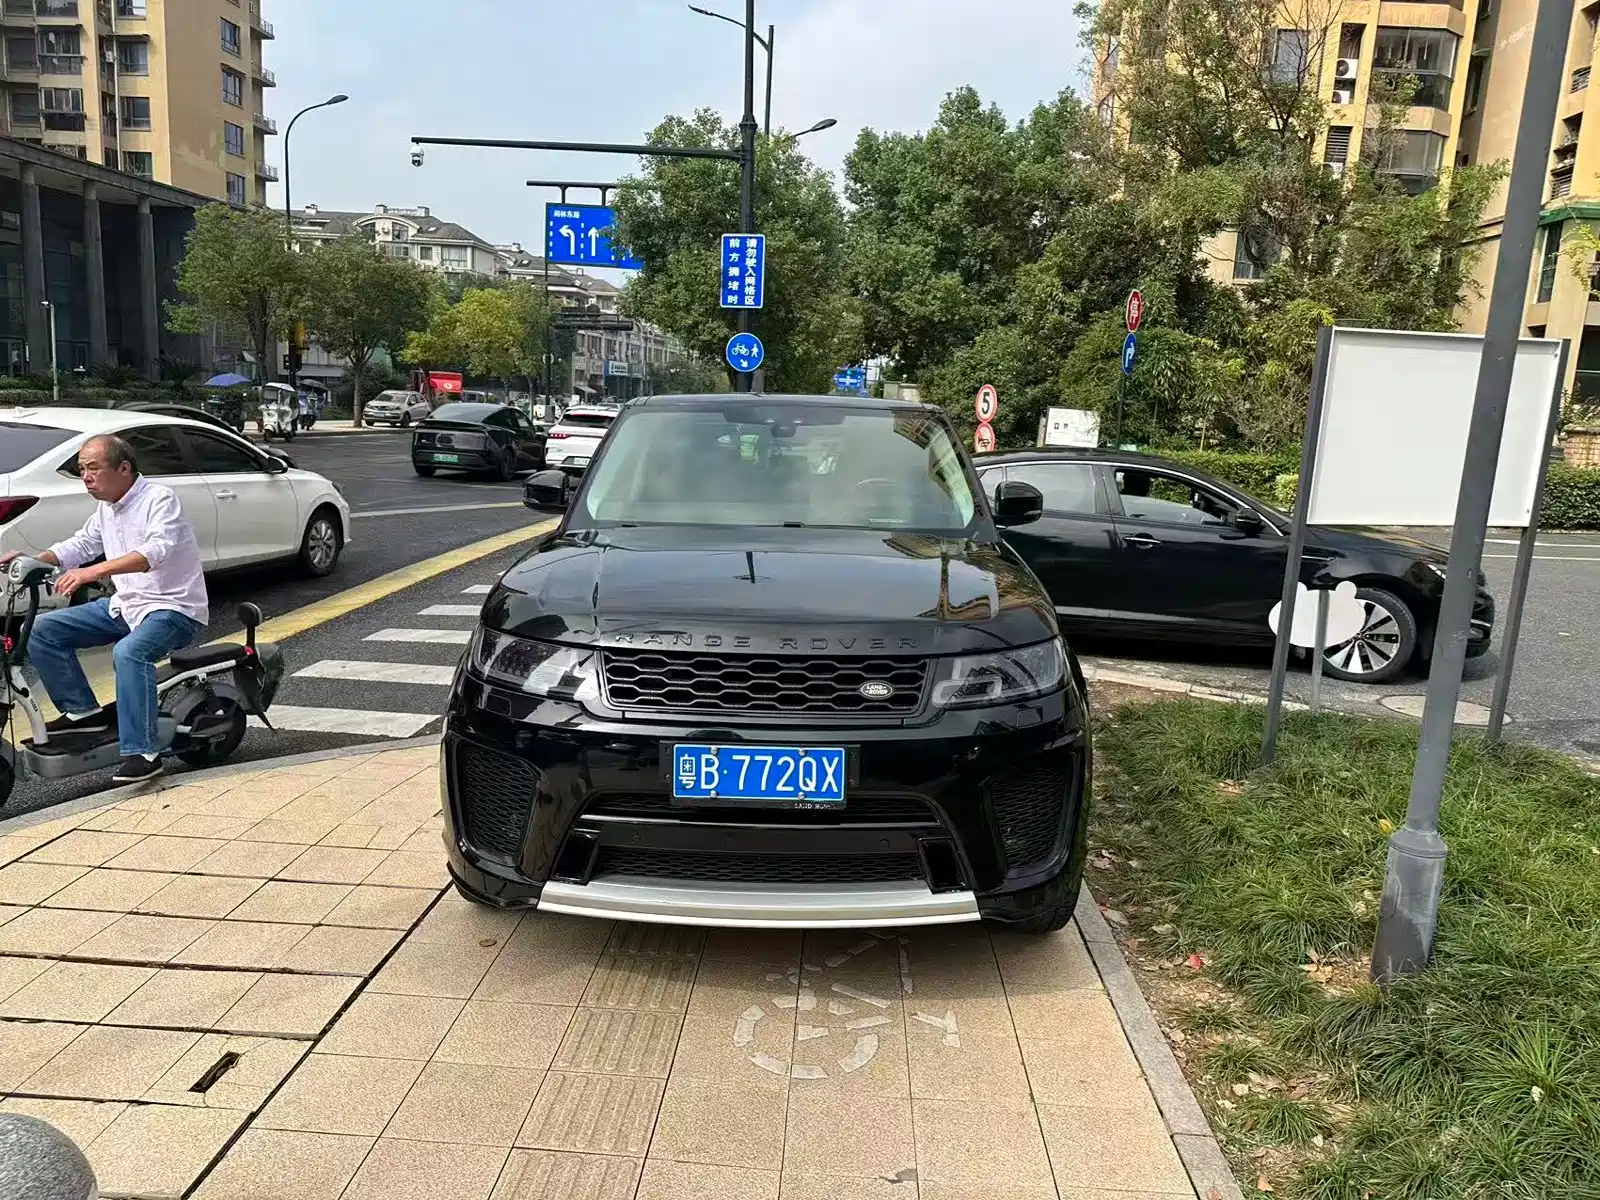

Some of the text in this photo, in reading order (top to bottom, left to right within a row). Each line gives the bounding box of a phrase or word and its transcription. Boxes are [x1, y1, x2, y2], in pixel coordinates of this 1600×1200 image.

[727, 238, 741, 305] 前方拥堵时
[744, 238, 757, 306] 请勿驶入网格区
[1129, 297, 1139, 324] 停
[981, 391, 991, 415] 5
[615, 633, 919, 650] RANGE ROVER
